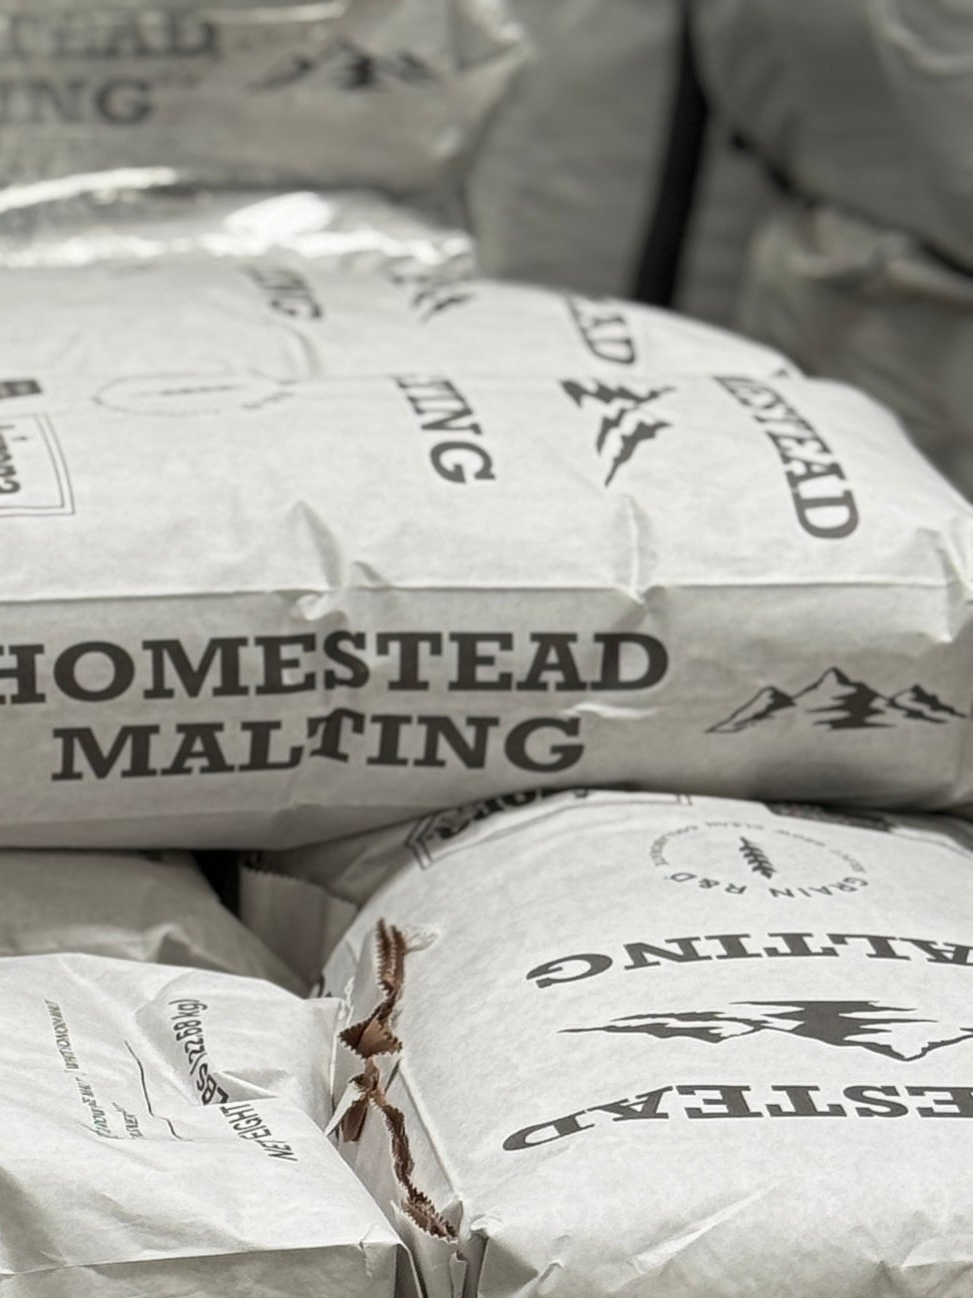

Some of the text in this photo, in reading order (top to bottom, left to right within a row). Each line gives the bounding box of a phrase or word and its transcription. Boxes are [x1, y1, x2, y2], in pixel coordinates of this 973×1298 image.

[50, 706, 588, 782] MALTING
[768, 876, 869, 898] GRAIN
[219, 1102, 271, 1146] EIGHT
